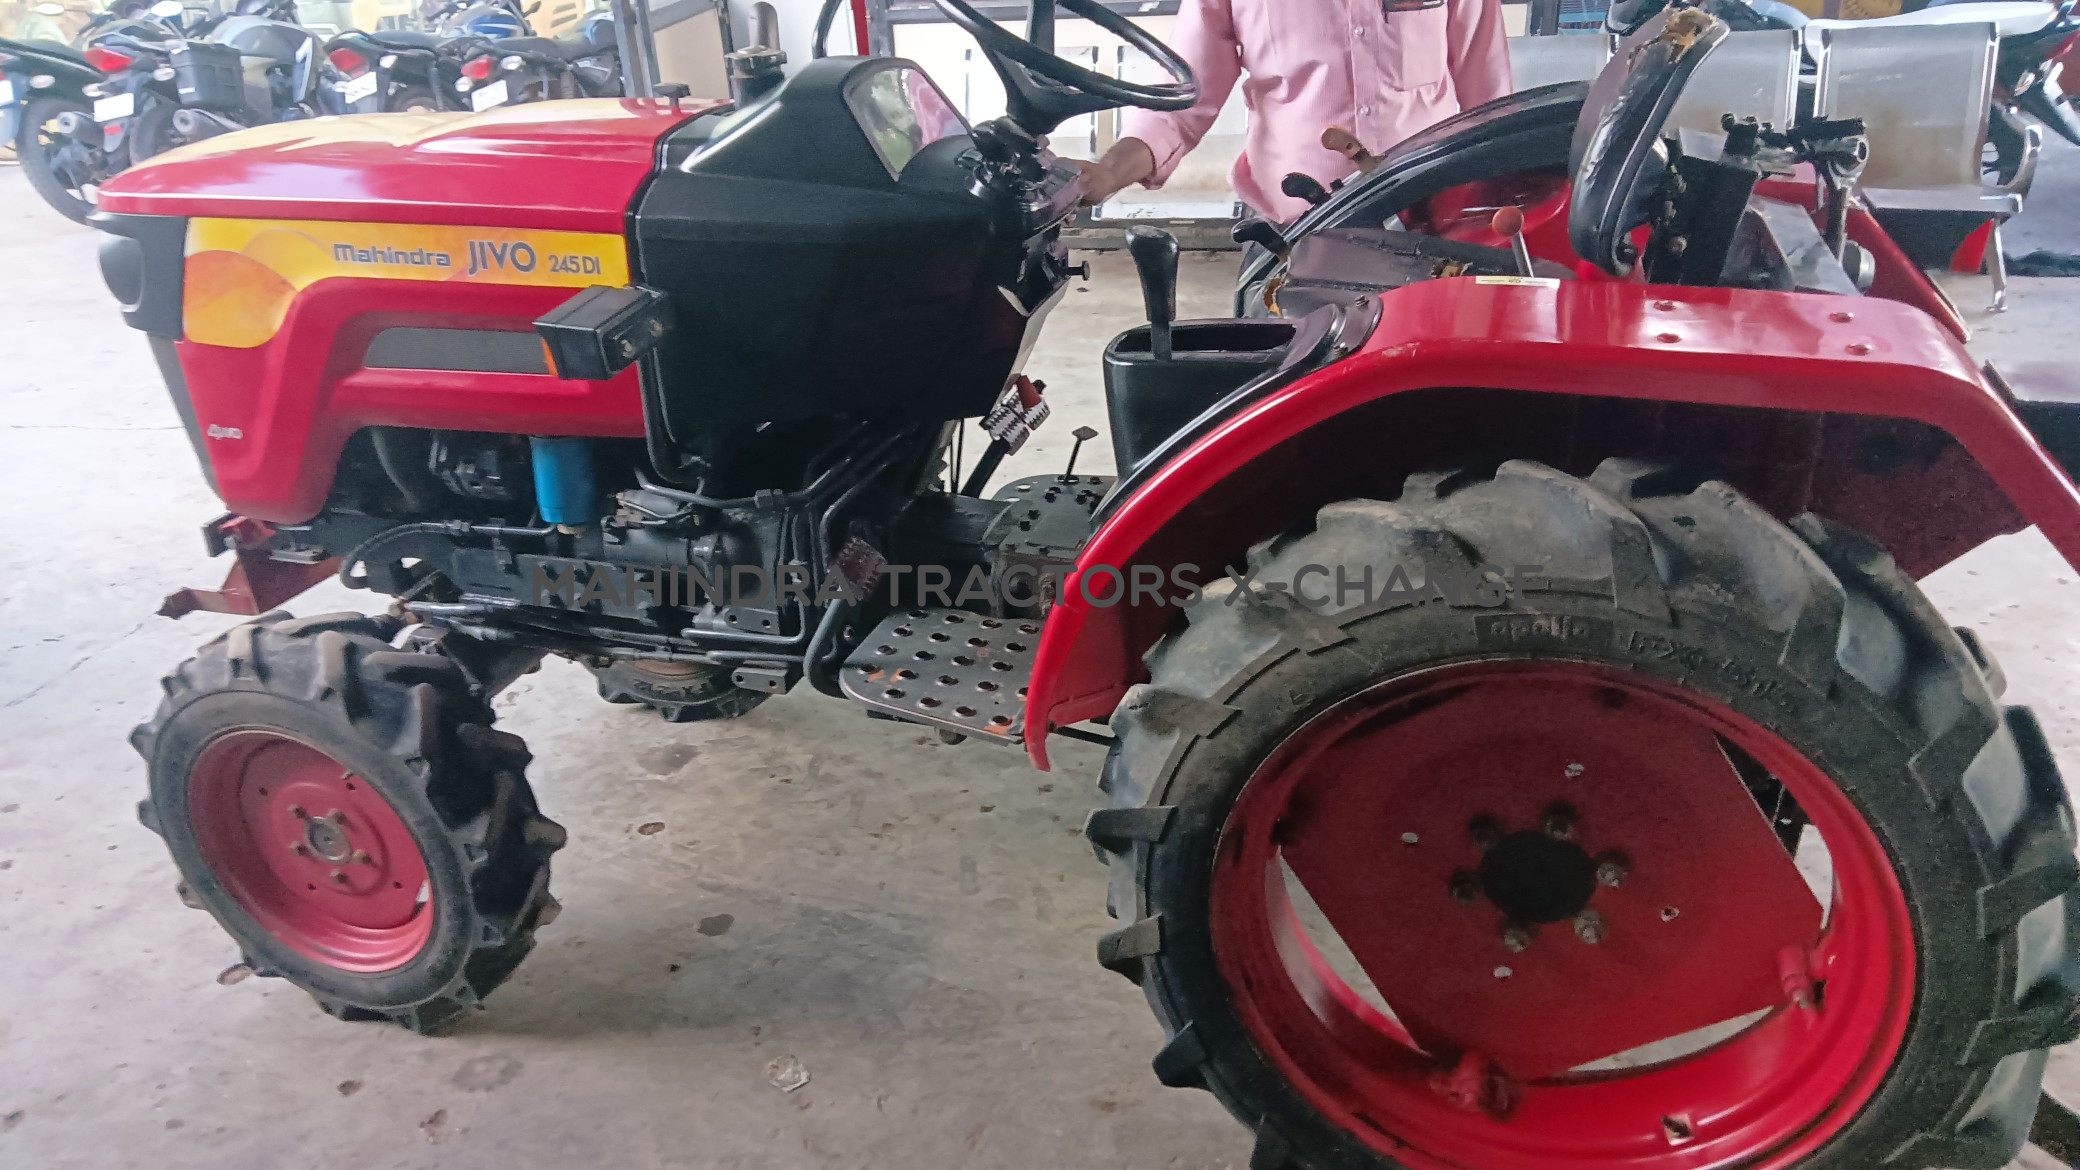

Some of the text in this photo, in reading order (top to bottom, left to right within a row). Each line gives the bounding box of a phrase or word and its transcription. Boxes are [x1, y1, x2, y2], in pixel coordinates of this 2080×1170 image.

[333, 240, 601, 276] Mahindra JIVO 245 DI
